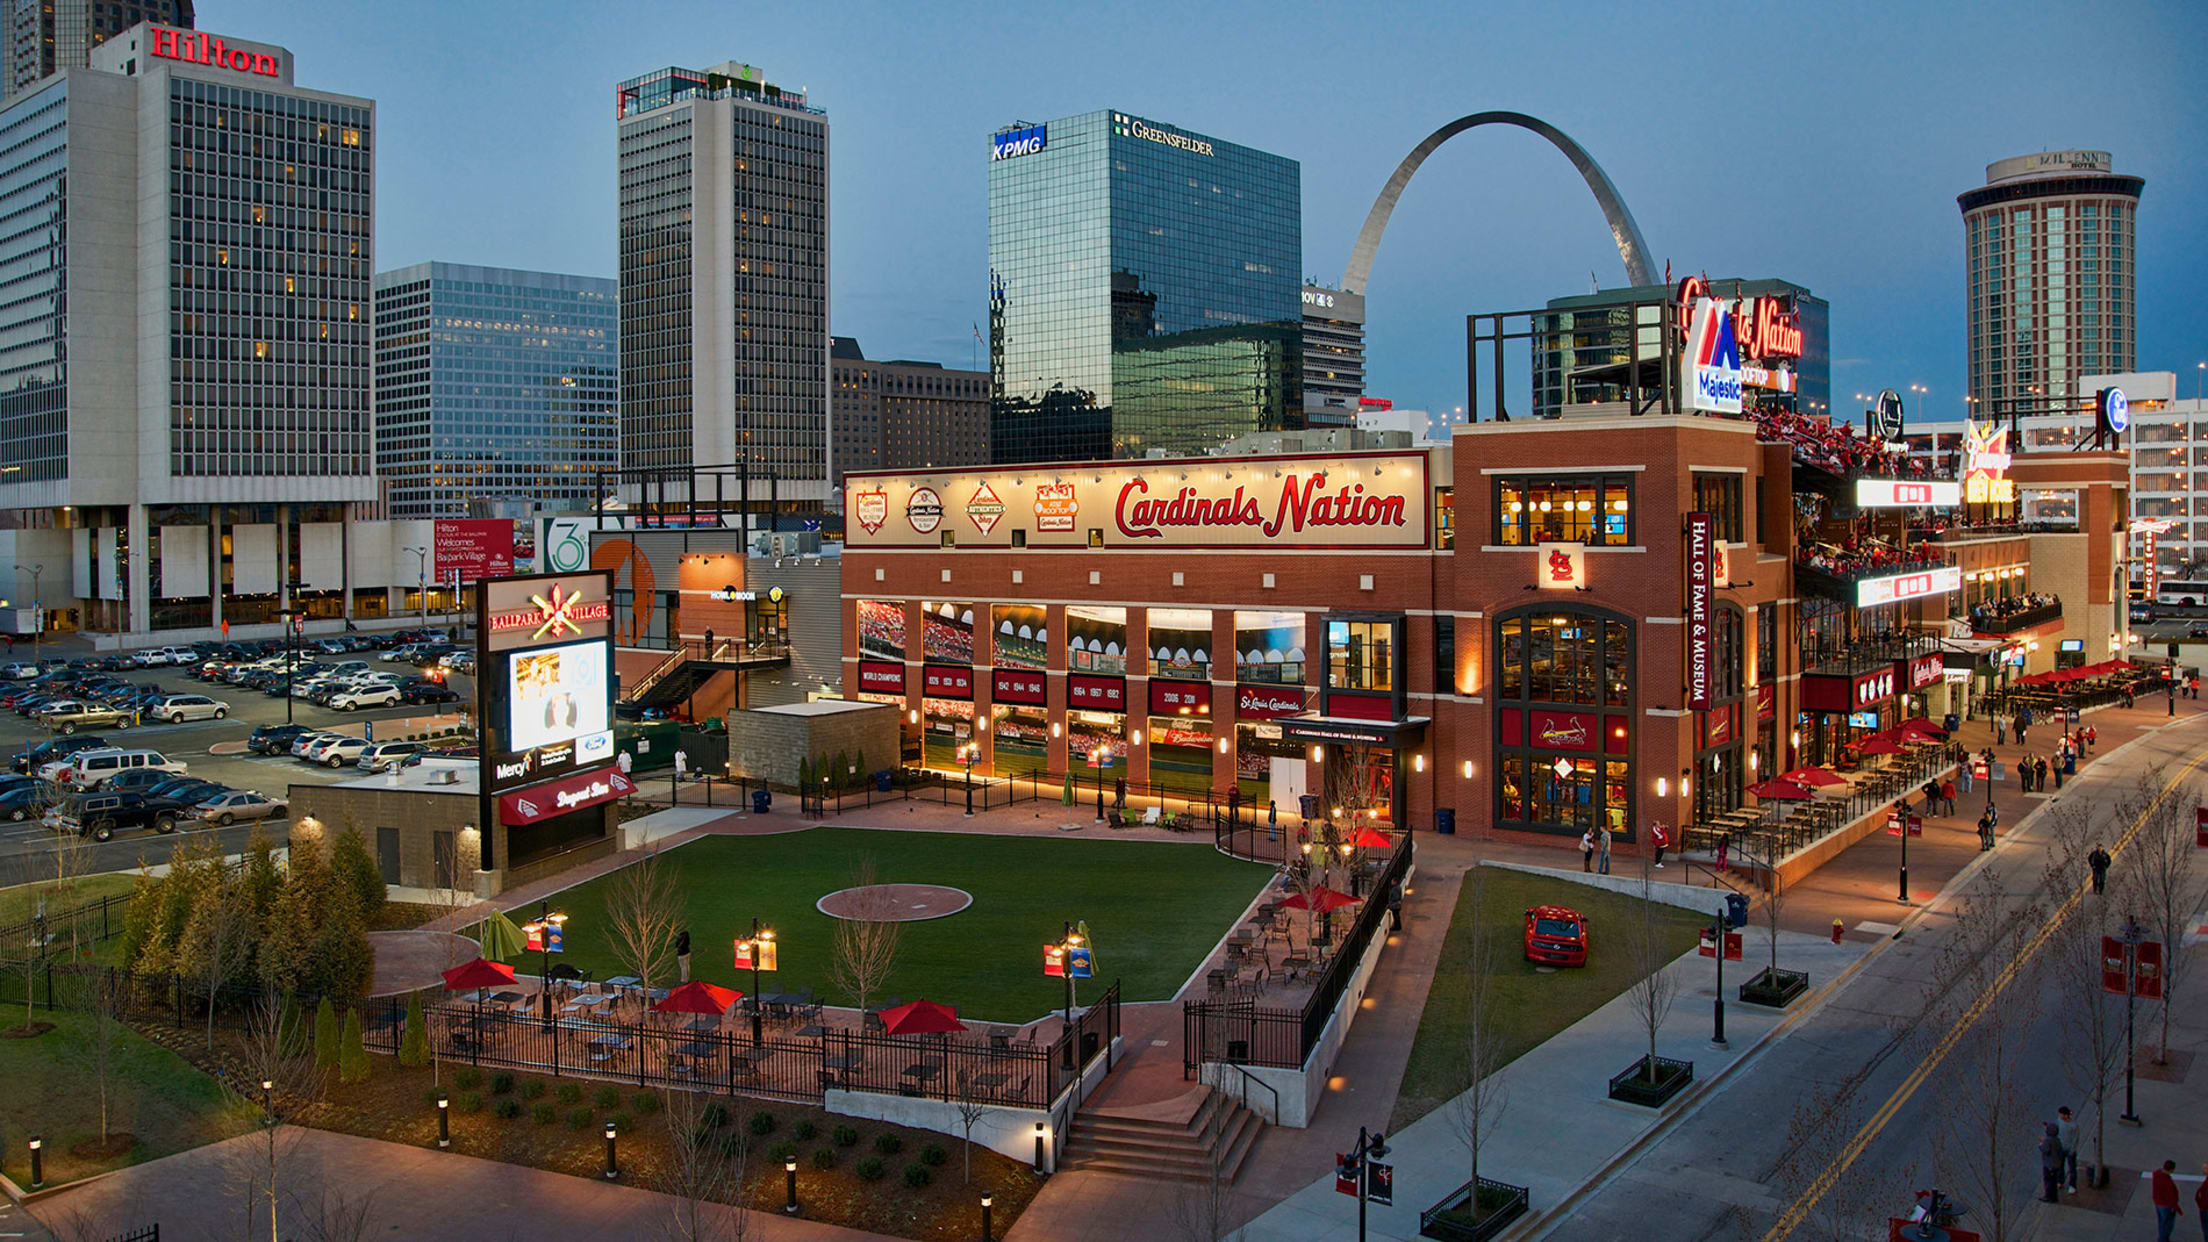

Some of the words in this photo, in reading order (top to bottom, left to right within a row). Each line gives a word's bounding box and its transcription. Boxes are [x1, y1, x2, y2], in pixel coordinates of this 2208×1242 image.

[150, 26, 279, 77] Hilton
[992, 136, 1040, 161] KPMG
[1132, 121, 1214, 157] GREENSFELDER
[1750, 297, 1803, 360] Nation
[1699, 371, 1741, 405] Majestic
[1115, 477, 1266, 539] Cardinals
[1262, 473, 1407, 538] Nation
[436, 524, 459, 532] Hilton
[1692, 521, 1706, 559] HALL
[437, 538, 475, 546] Welcomes
[437, 553, 464, 563] Bapark
[1692, 561, 1705, 580] OF
[1692, 584, 1706, 621] FAME
[491, 611, 542, 630] BALLPARK
[570, 604, 609, 620] VILLAGE
[1692, 624, 1706, 637] &
[1692, 639, 1706, 702] MUSEUM
[1250, 697, 1268, 711] Louis
[1268, 698, 1300, 711] Cardinals
[496, 761, 525, 780] Mercy
